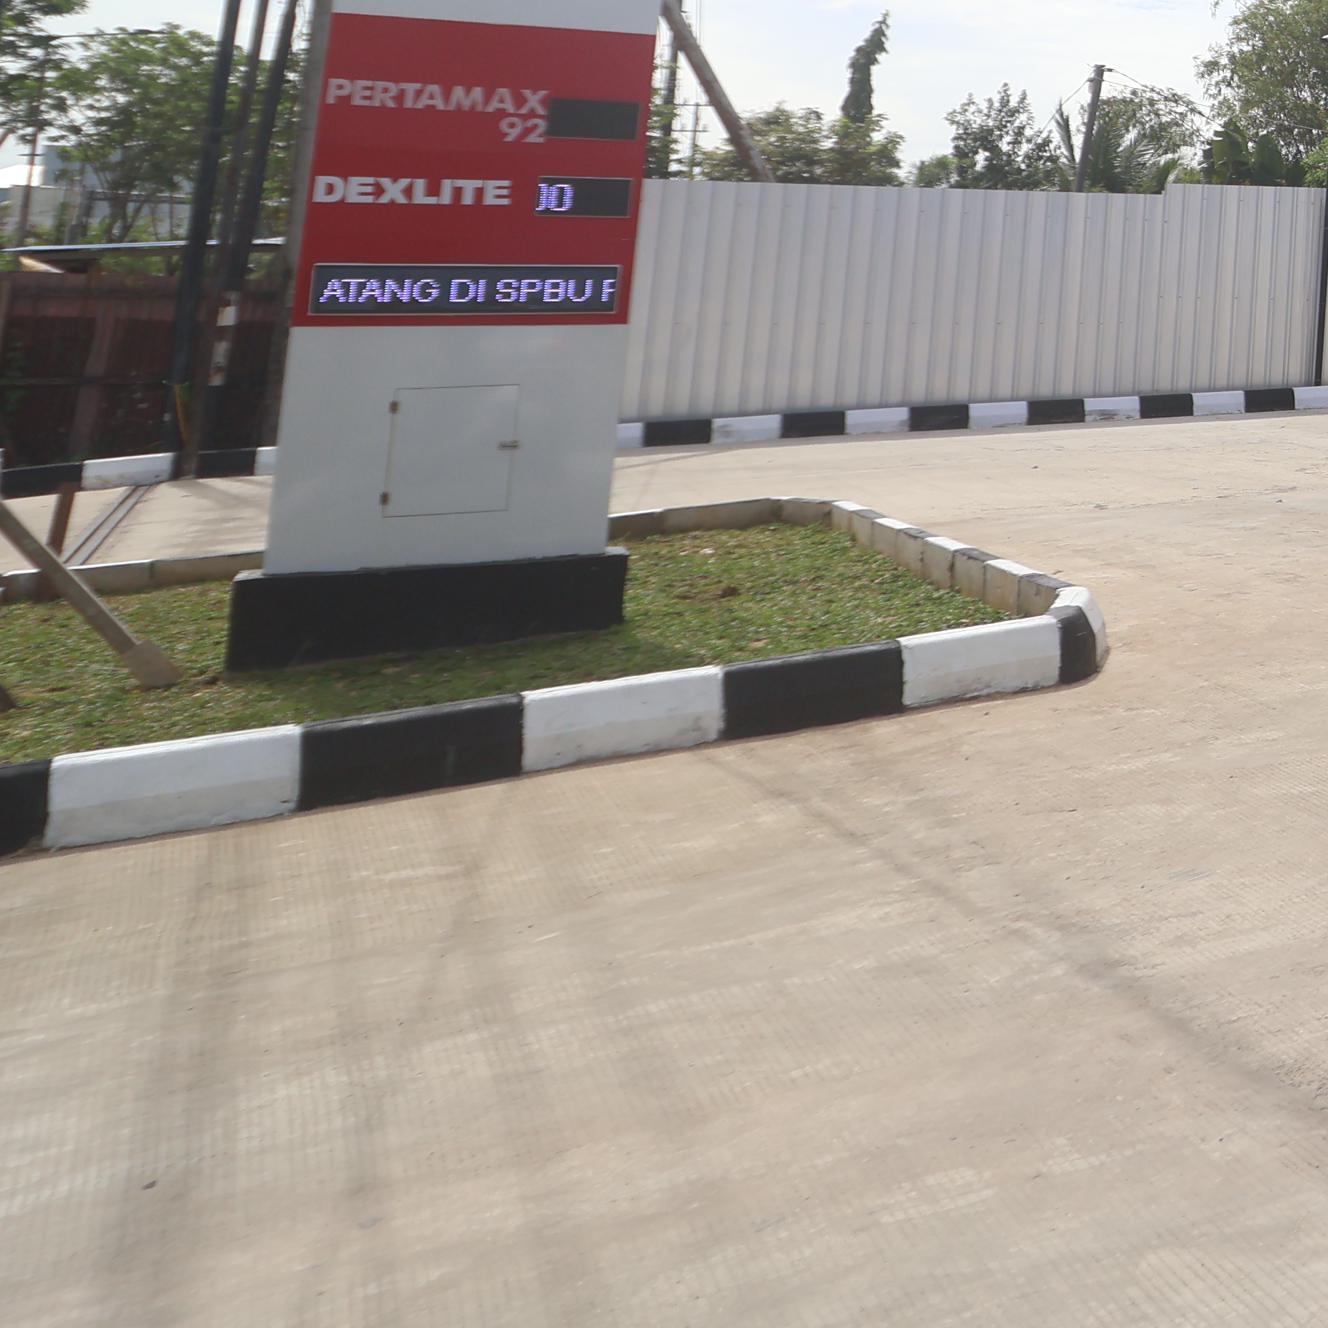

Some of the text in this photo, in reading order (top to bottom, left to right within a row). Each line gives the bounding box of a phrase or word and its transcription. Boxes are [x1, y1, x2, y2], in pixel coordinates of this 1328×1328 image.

[325, 78, 549, 115] PERTAMAX
[499, 117, 547, 143] 92
[312, 175, 513, 206] DEXLITE
[319, 279, 440, 303] ATANG
[449, 279, 487, 303] DI
[495, 279, 593, 303] SPBU
